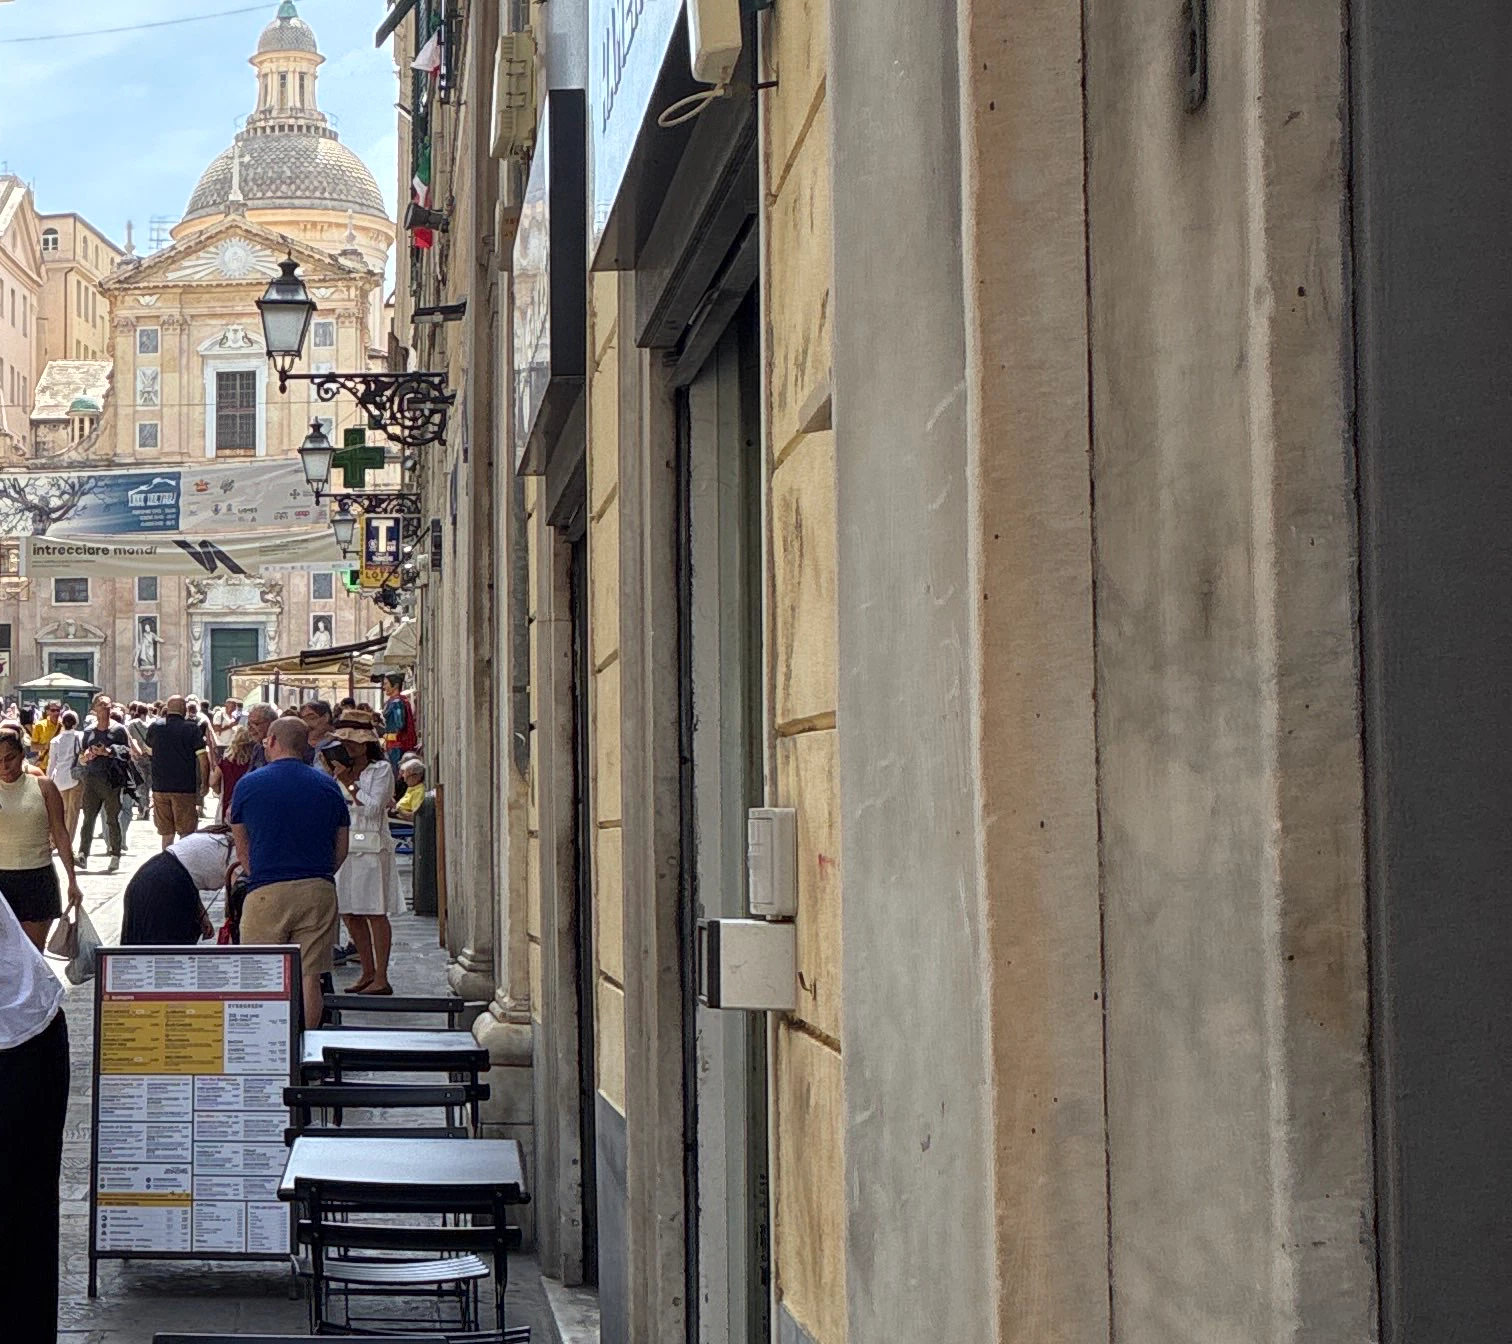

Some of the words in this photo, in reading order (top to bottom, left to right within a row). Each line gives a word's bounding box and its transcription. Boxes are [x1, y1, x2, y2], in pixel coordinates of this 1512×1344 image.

[371, 519, 395, 553] T
[32, 543, 110, 557] intrecciare
[113, 545, 158, 556] mondi
[365, 571, 401, 580] LOTO
